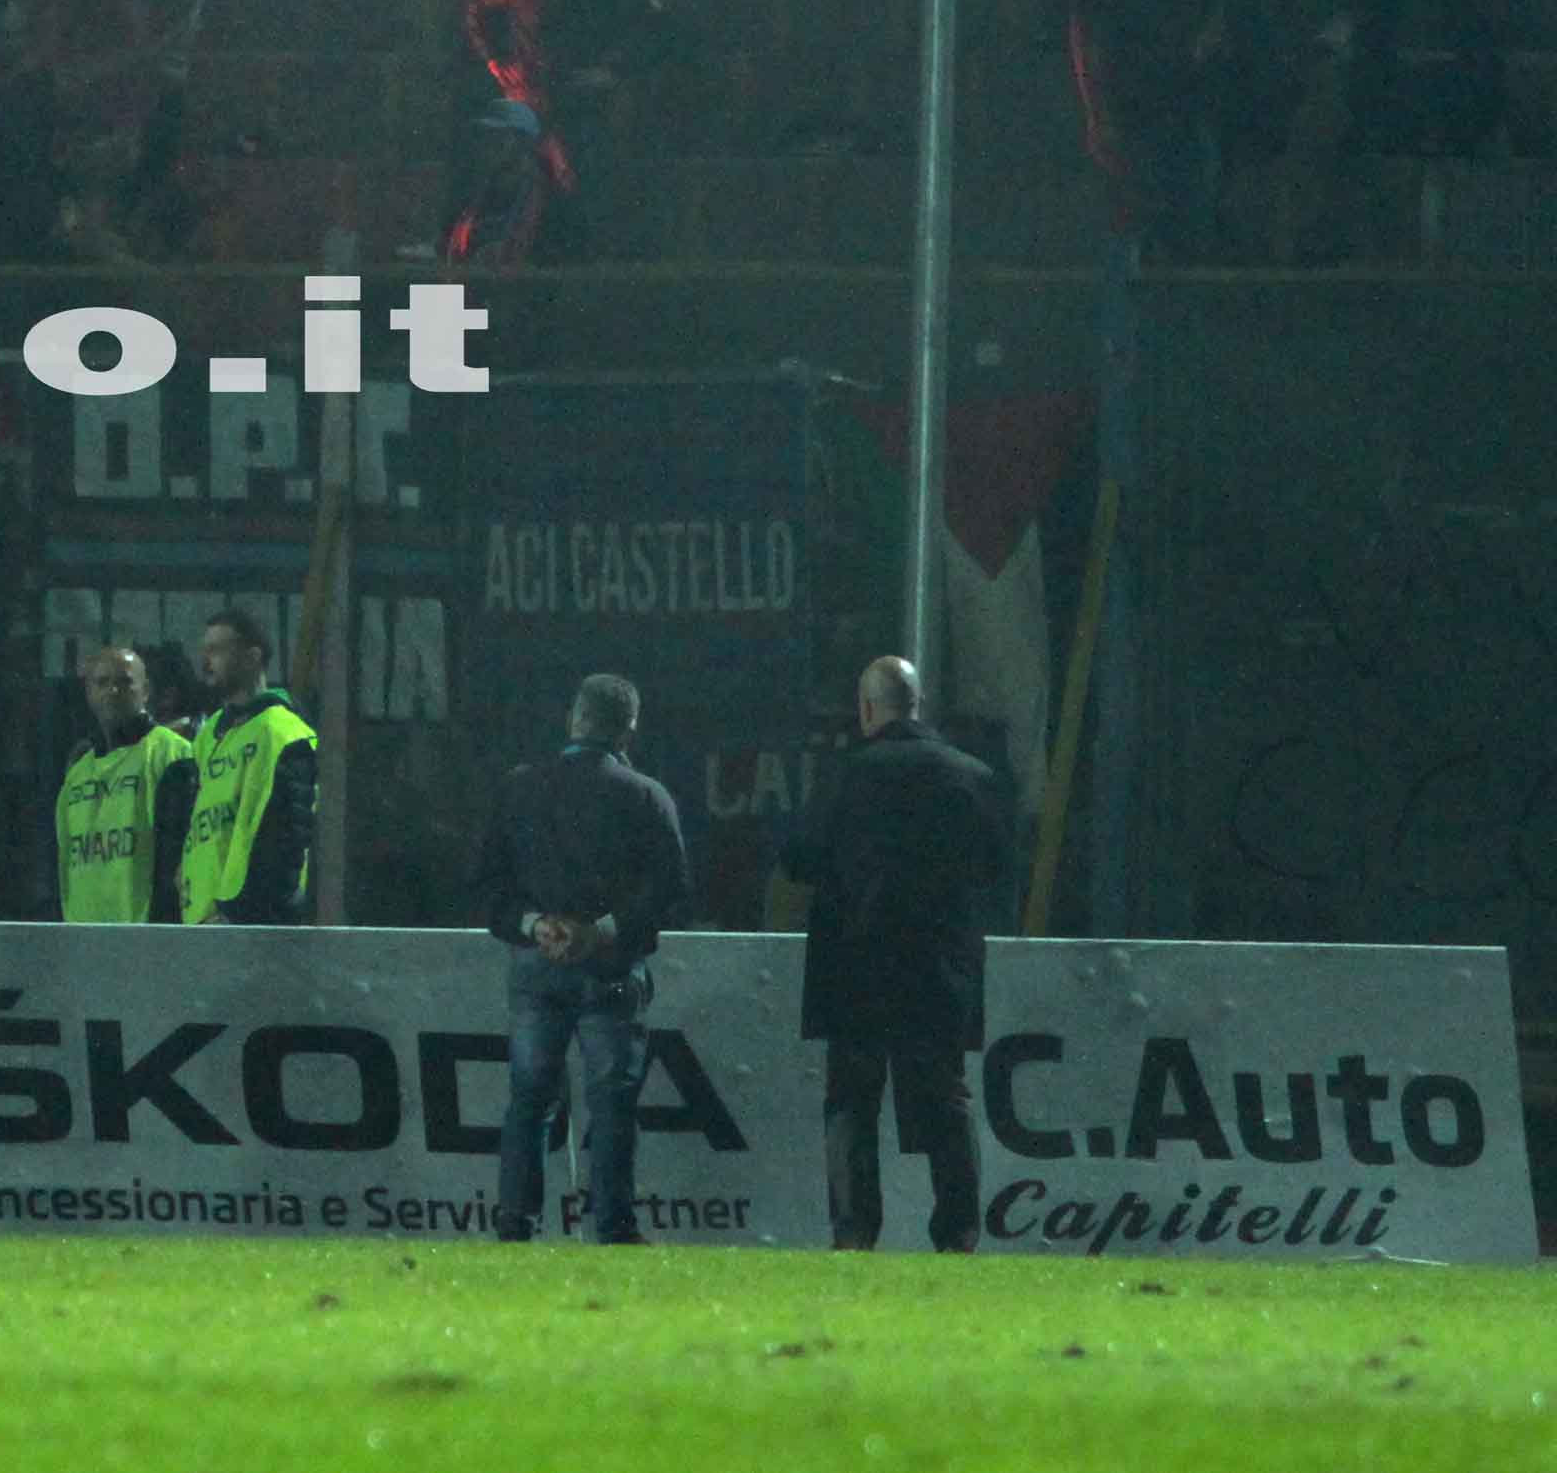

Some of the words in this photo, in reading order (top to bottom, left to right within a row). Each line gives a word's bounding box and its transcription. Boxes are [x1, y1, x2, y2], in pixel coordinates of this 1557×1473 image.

[487, 524, 558, 614] ACI
[573, 524, 795, 614] CASTELLO
[321, 1195, 349, 1227] e
[985, 1178, 1401, 1255] Capitelli
